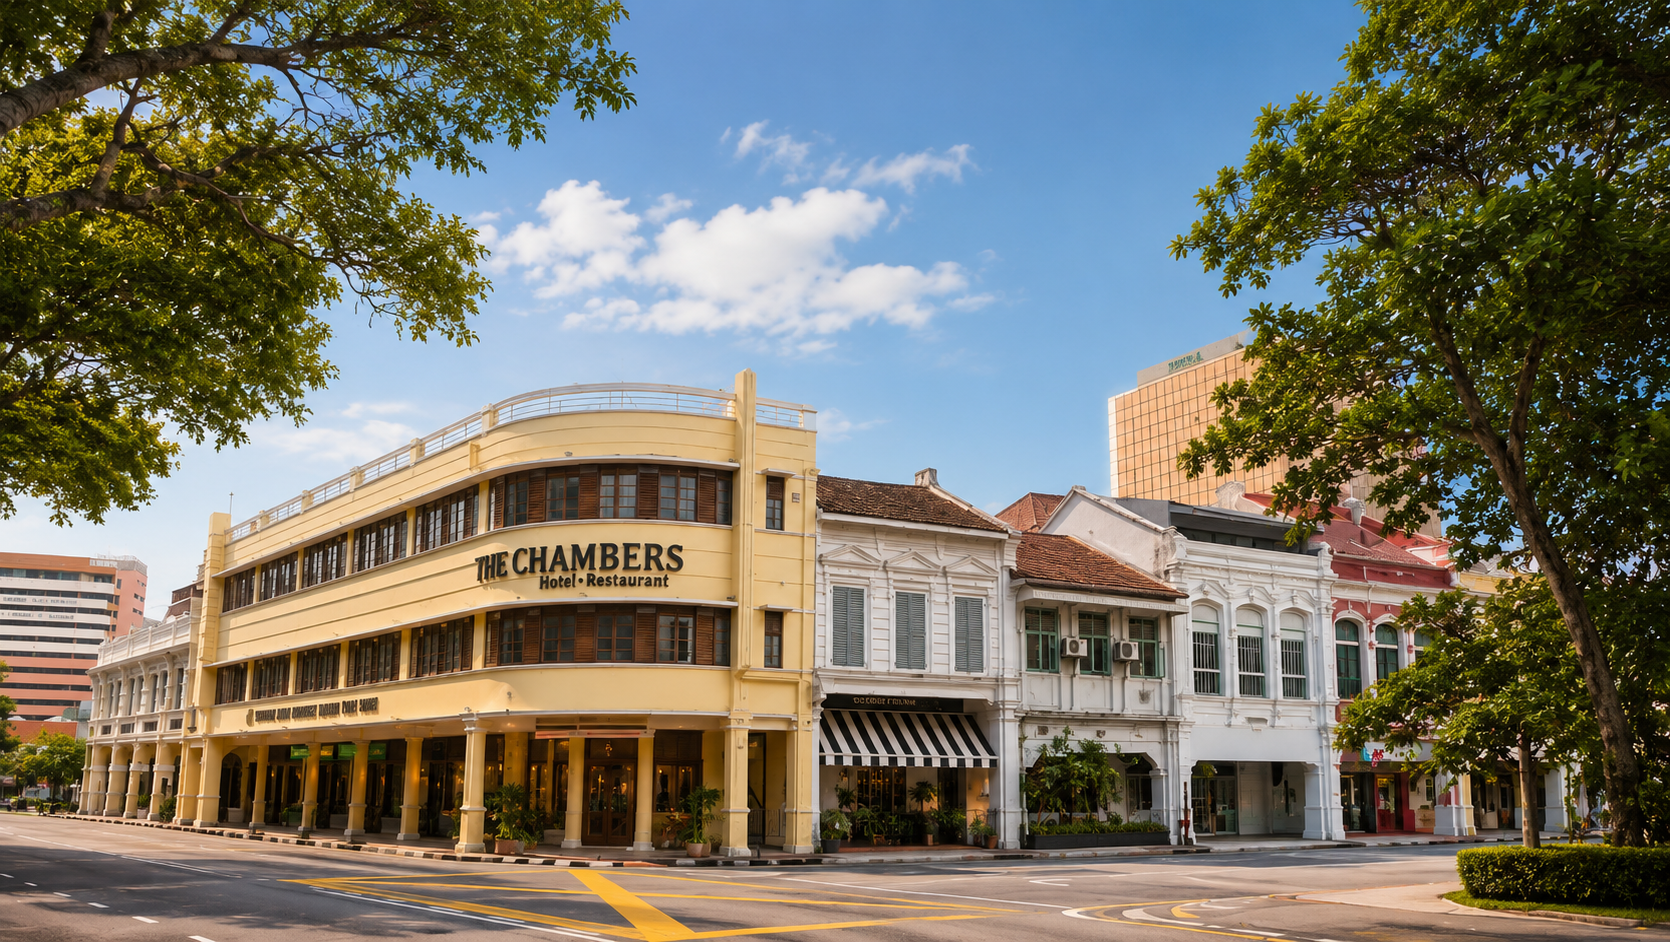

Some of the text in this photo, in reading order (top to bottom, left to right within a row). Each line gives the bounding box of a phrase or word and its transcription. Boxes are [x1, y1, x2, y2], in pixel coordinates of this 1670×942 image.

[475, 543, 683, 583] THE CHAMBERS
[539, 573, 669, 589] Hotel Restaurant
